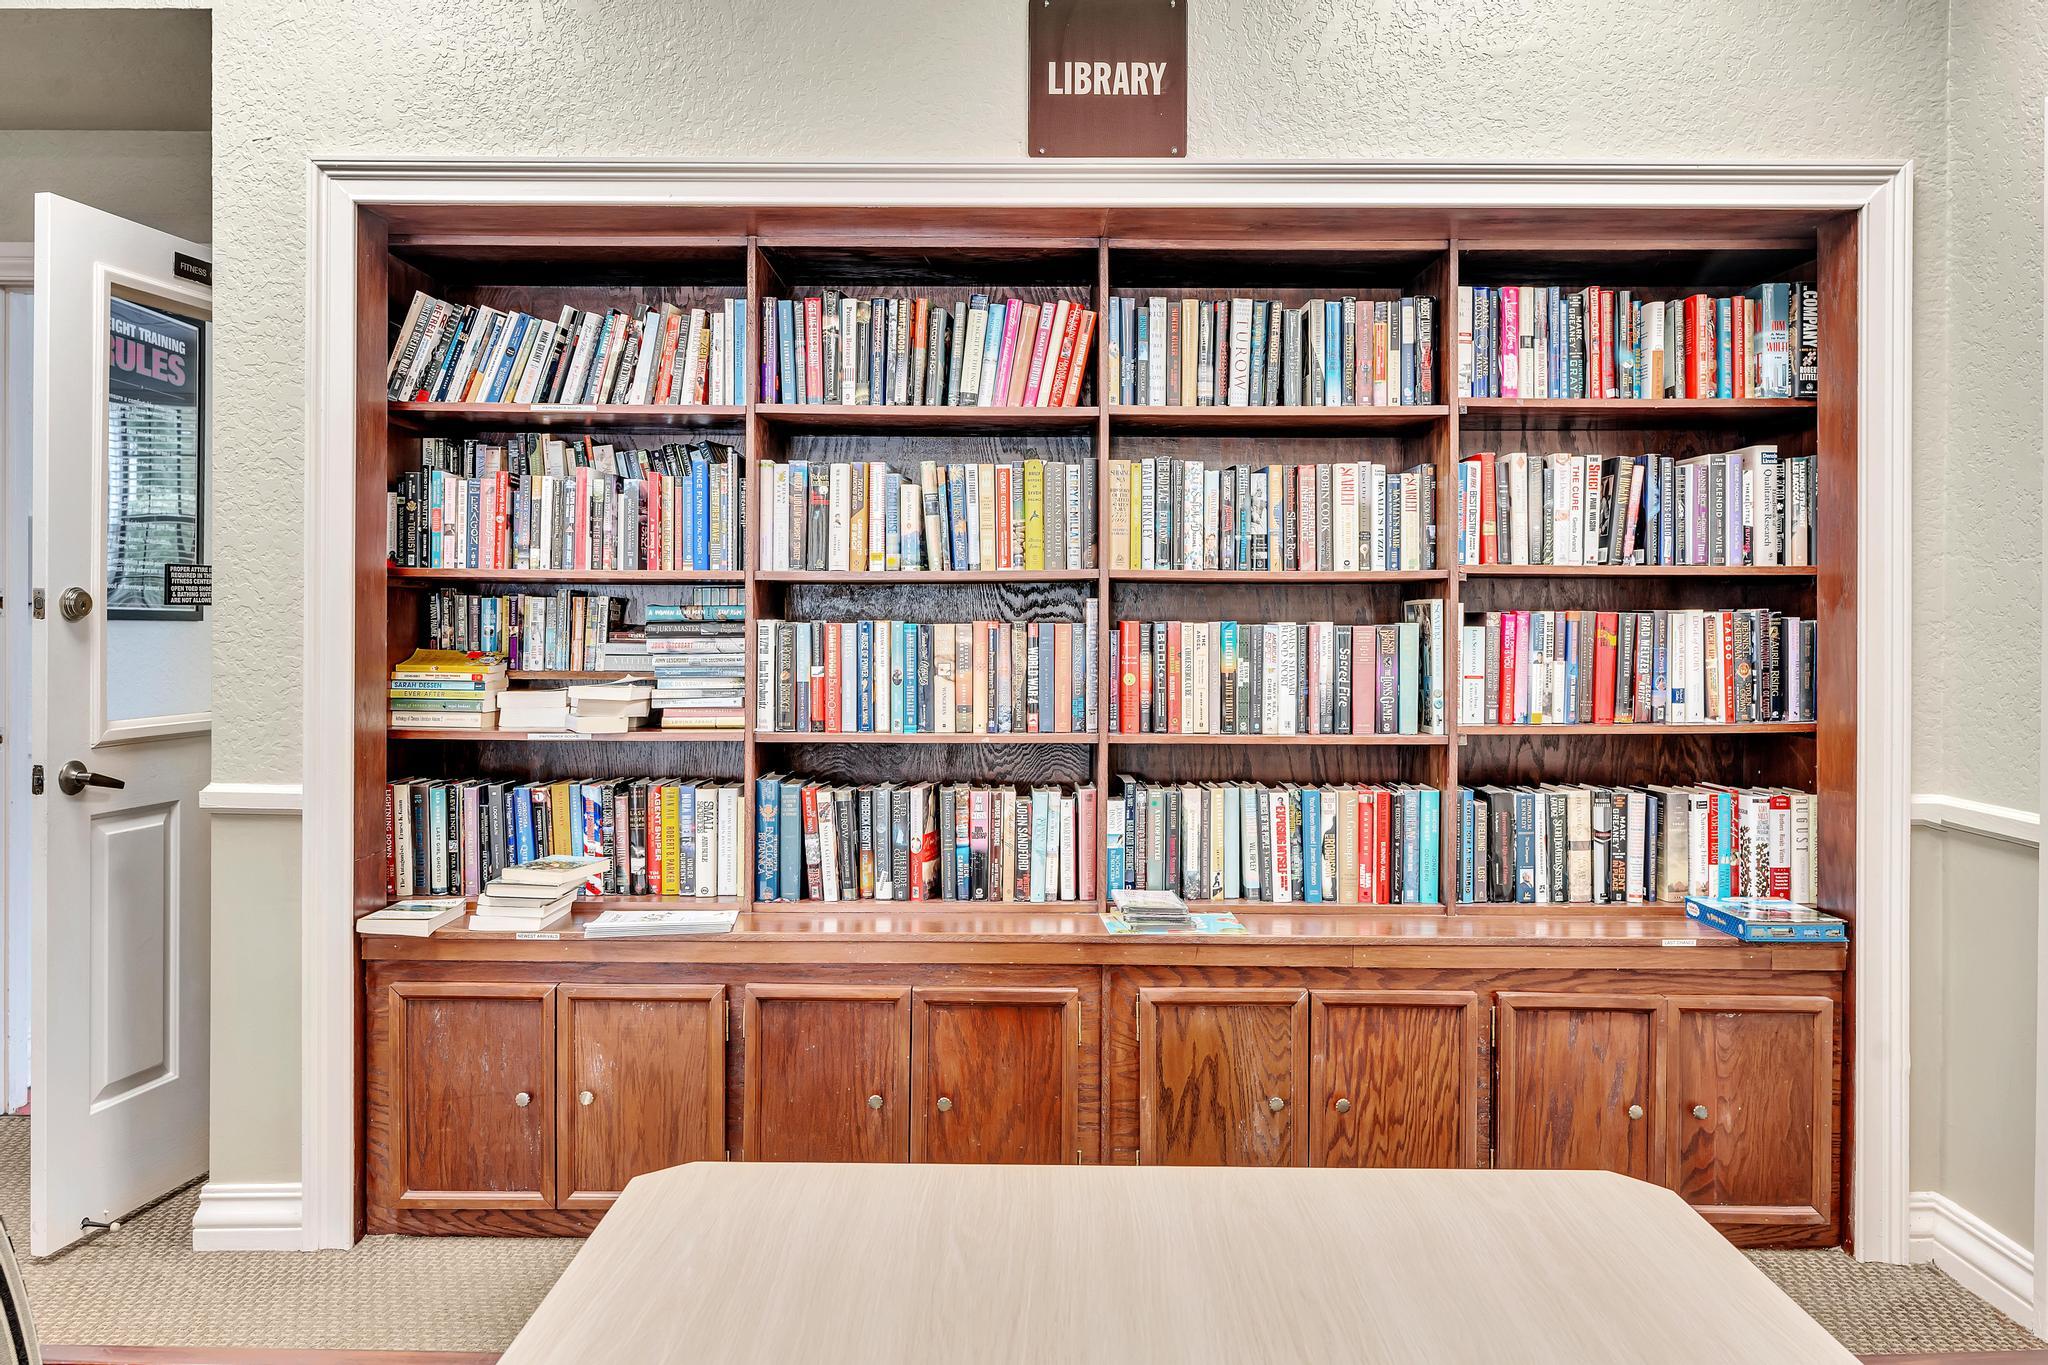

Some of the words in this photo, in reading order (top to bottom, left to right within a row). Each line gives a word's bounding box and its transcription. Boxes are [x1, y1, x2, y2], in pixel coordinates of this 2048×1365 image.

[1048, 61, 1167, 96] LIBRARY
[180, 262, 207, 277] FITNESS
[414, 302, 433, 332] HISTORY'S
[424, 304, 444, 340] RETREAT
[897, 299, 907, 328] STUART
[1171, 307, 1180, 333] HUNTER
[1271, 303, 1280, 334] STUART
[1421, 298, 1431, 320] ROBERT
[1474, 296, 1483, 331] MONEY
[1802, 290, 1818, 349] COMPANY
[139, 326, 186, 355] TRAINING
[897, 326, 906, 354] WOODS
[1421, 320, 1431, 343] LUDLUM
[1568, 307, 1577, 349] GREANEY
[405, 331, 424, 359] GREATEST
[1171, 335, 1179, 356] KILLER
[1234, 320, 1249, 391] TUROW
[1270, 335, 1279, 363] WOODS
[1345, 334, 1355, 360] Short
[398, 359, 411, 376] WARS
[1345, 361, 1354, 390] Straw
[1569, 359, 1578, 392] GRAY
[1069, 469, 1079, 497] TERRY
[1142, 464, 1152, 491] DAVID
[1239, 467, 1249, 495] Griffin
[1321, 467, 1330, 500] ROBIN
[1572, 466, 1580, 483] THE
[1054, 467, 1062, 515] AMERICAN
[1571, 486, 1579, 511] CURE
[1762, 468, 1772, 512] Qualitative
[470, 495, 479, 545] ERAGON
[1069, 499, 1079, 544] McMILLAN
[1142, 495, 1153, 540] BRINKLEY
[1321, 501, 1330, 532] COOK
[1798, 491, 1806, 528] STRAIGHT
[1286, 511, 1296, 542] Shrink
[1763, 513, 1772, 547] Research
[1284, 543, 1296, 561] Rap
[656, 625, 673, 634] JURY
[672, 624, 700, 632] MASTER
[1280, 624, 1289, 658] BLOOD
[1641, 615, 1651, 637] BRAD
[1707, 619, 1715, 647] COVER
[1734, 617, 1743, 660] McKIERNAN
[1028, 647, 1038, 676] WORLD
[1339, 647, 1351, 683] Sacred
[1639, 639, 1651, 674] MELTZER
[1028, 677, 1038, 696] WAR
[1280, 660, 1289, 688] SPORT
[1339, 686, 1350, 707] Fire
[449, 788, 457, 812] MAEVE
[654, 792, 662, 825] AGENT
[681, 793, 692, 814] NORA
[861, 796, 871, 826] FREDERICK
[1016, 803, 1028, 825] JOHN
[449, 813, 457, 839] BINCHY
[681, 815, 692, 846] ROBERTS
[696, 800, 704, 834] SACRIFICES
[703, 800, 714, 833] SMALL
[840, 807, 848, 839] TUROW
[1276, 806, 1287, 845] EXPOSING
[1612, 808, 1620, 849] GREANEY
[1795, 798, 1809, 853] AUGUST
[861, 826, 871, 851] FORSYTH
[1016, 827, 1029, 871] SANDFORD
[1477, 822, 1486, 852] FIELDING
[758, 832, 766, 874] BRITANNICA
[1277, 845, 1287, 875] MYSELF
[1612, 860, 1619, 868] IN
[893, 848, 901, 889] COLLECTOR
[1618, 860, 1626, 892] AGENT
